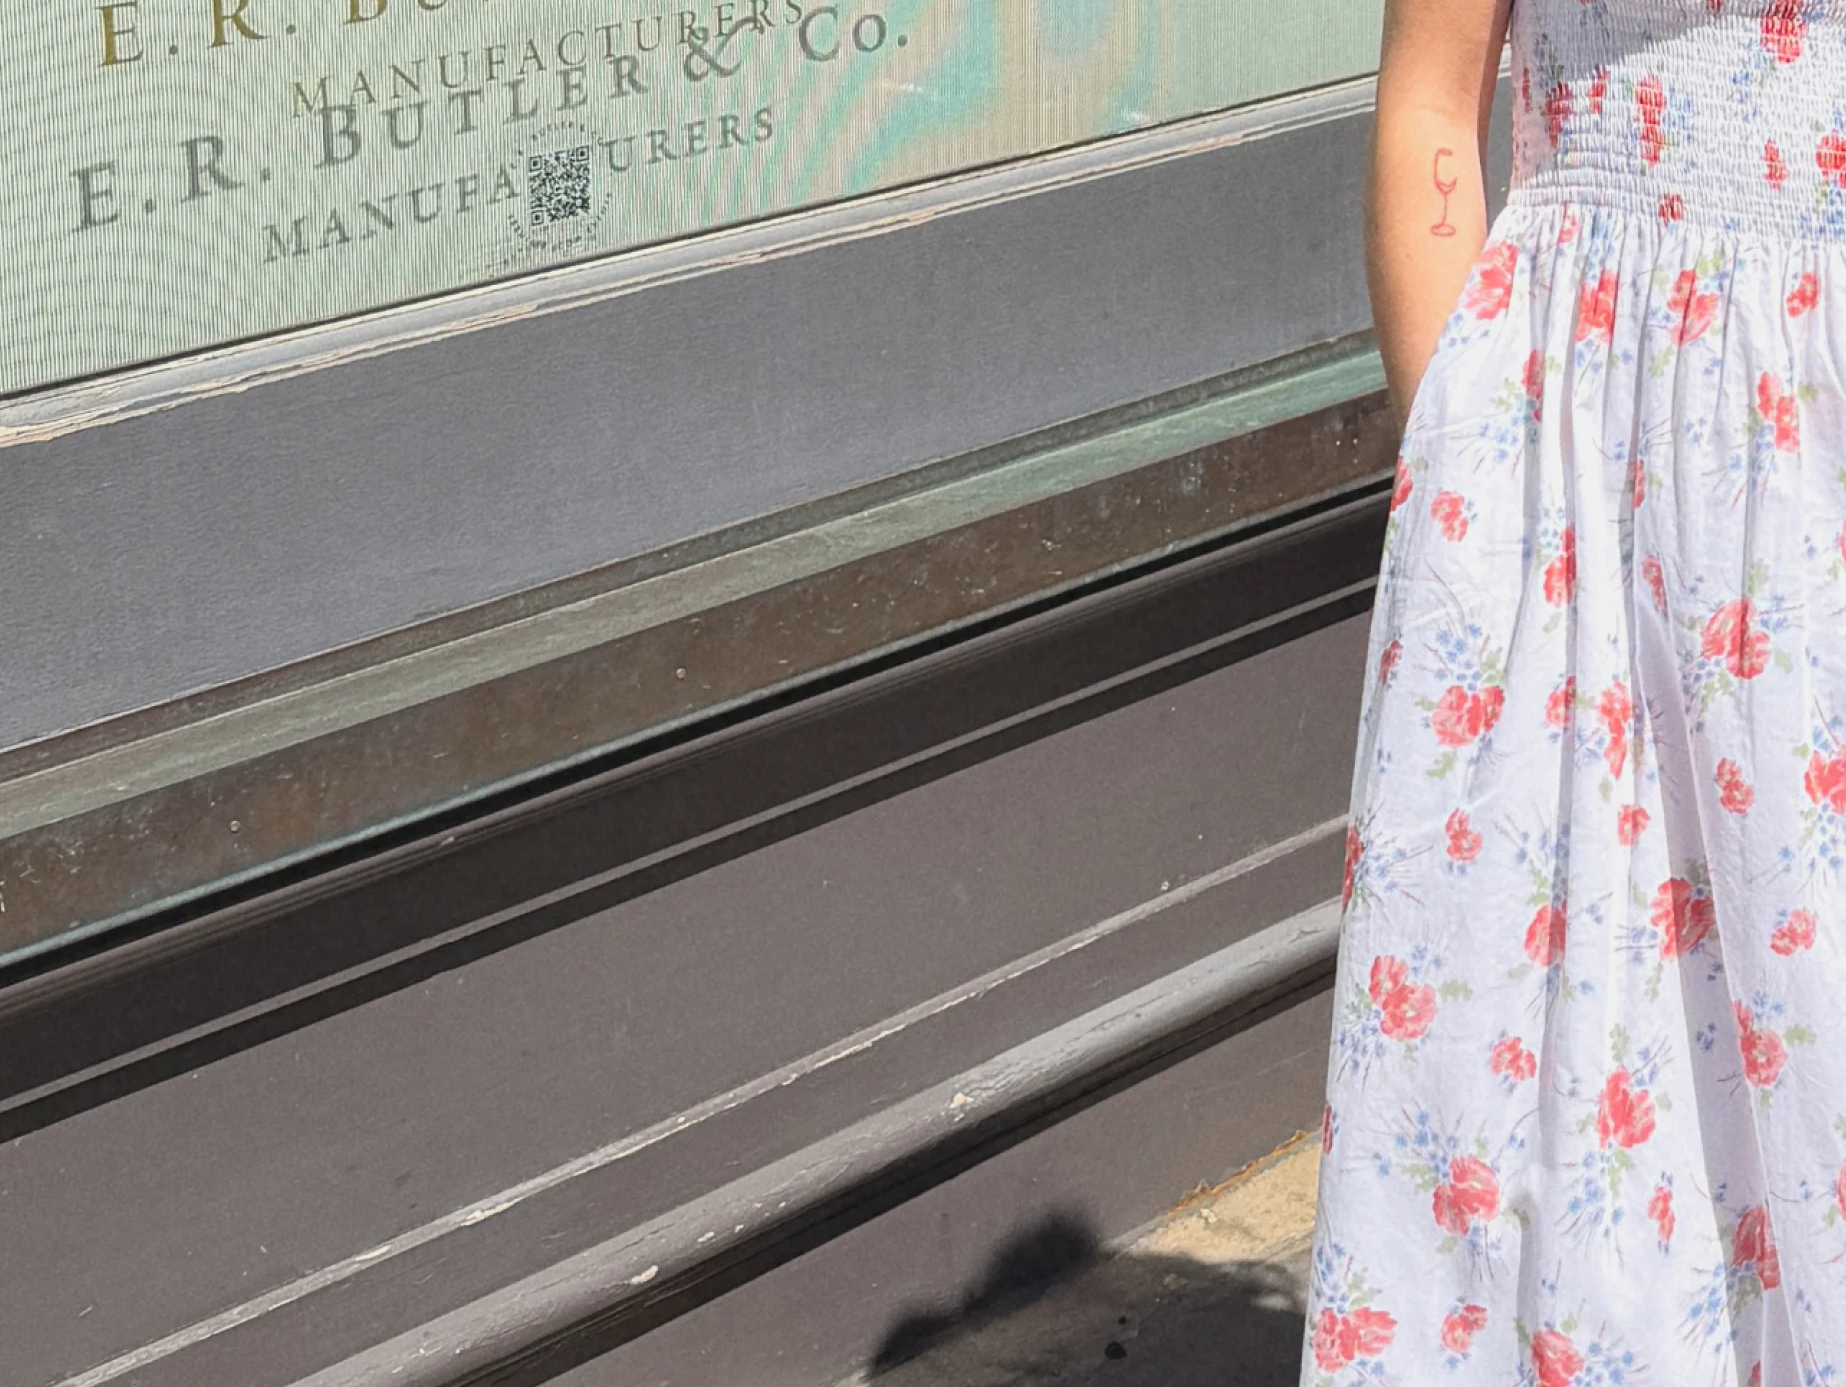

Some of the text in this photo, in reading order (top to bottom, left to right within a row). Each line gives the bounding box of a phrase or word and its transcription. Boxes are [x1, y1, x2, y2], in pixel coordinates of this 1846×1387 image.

[314, 54, 648, 170] BUTLER
[684, 16, 766, 82] &
[263, 108, 774, 263] MANUFAURERS
